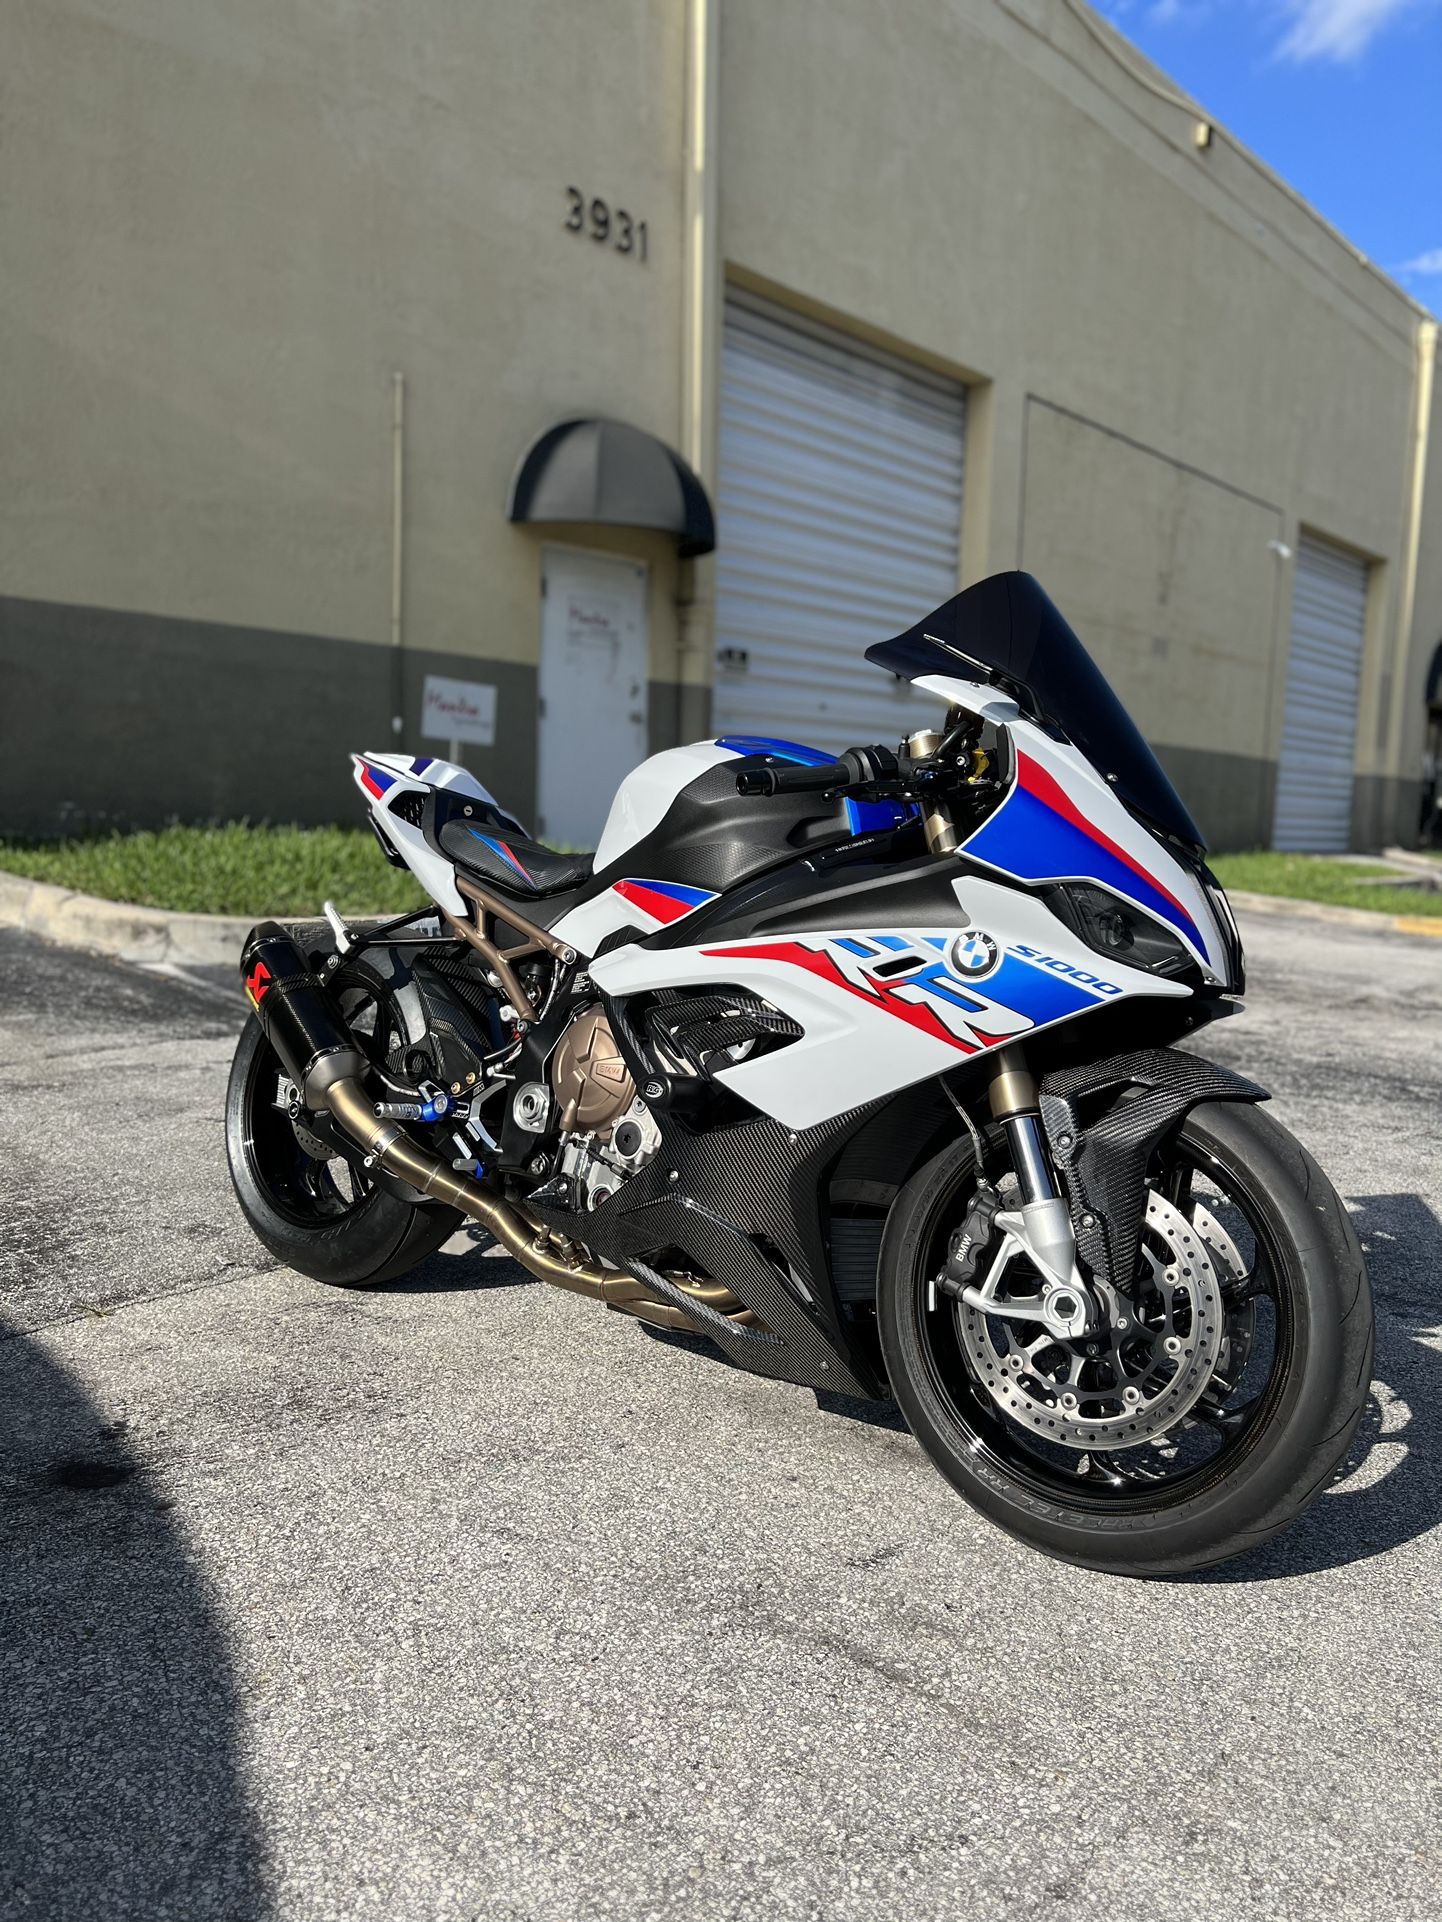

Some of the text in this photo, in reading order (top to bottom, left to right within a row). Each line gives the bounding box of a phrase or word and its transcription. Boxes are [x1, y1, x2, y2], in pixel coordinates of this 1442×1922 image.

[565, 185, 648, 263] 3931
[1006, 944, 1123, 994] S1000
[955, 1233, 972, 1262] BMW
